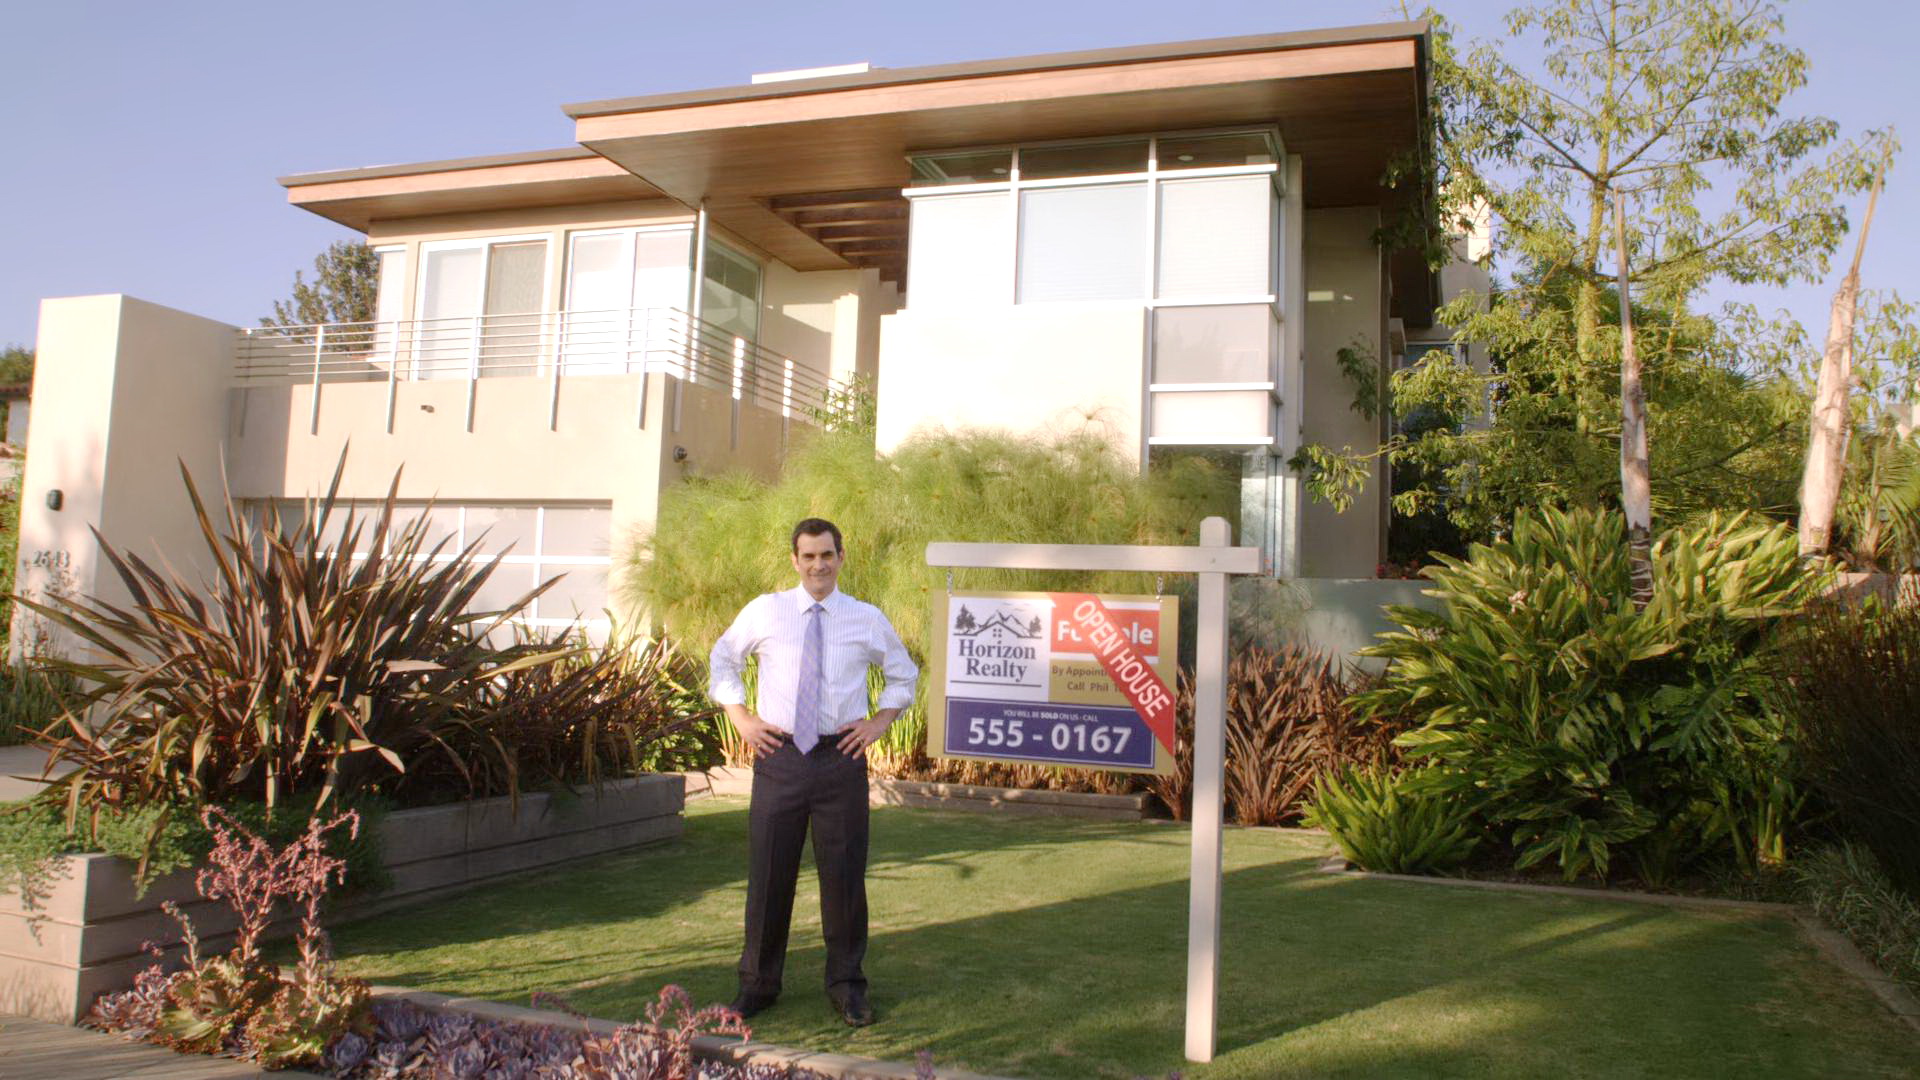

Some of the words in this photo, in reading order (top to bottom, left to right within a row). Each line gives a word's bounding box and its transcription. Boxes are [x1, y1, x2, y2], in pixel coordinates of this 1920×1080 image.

[959, 639, 1036, 660] Horizon
[1073, 600, 1123, 656] OPEN
[1109, 647, 1170, 718] HOUSE
[966, 657, 1028, 682] Realty
[1052, 665, 1064, 676] By
[1066, 666, 1108, 677] Appoint
[1067, 682, 1085, 691] Call
[1090, 682, 1109, 692] Phil
[1003, 709, 1016, 717] YOU
[1040, 711, 1059, 720] SOLD
[1082, 714, 1099, 722] CALL
[968, 717, 1024, 748] 555
[1051, 723, 1132, 754] 0167
